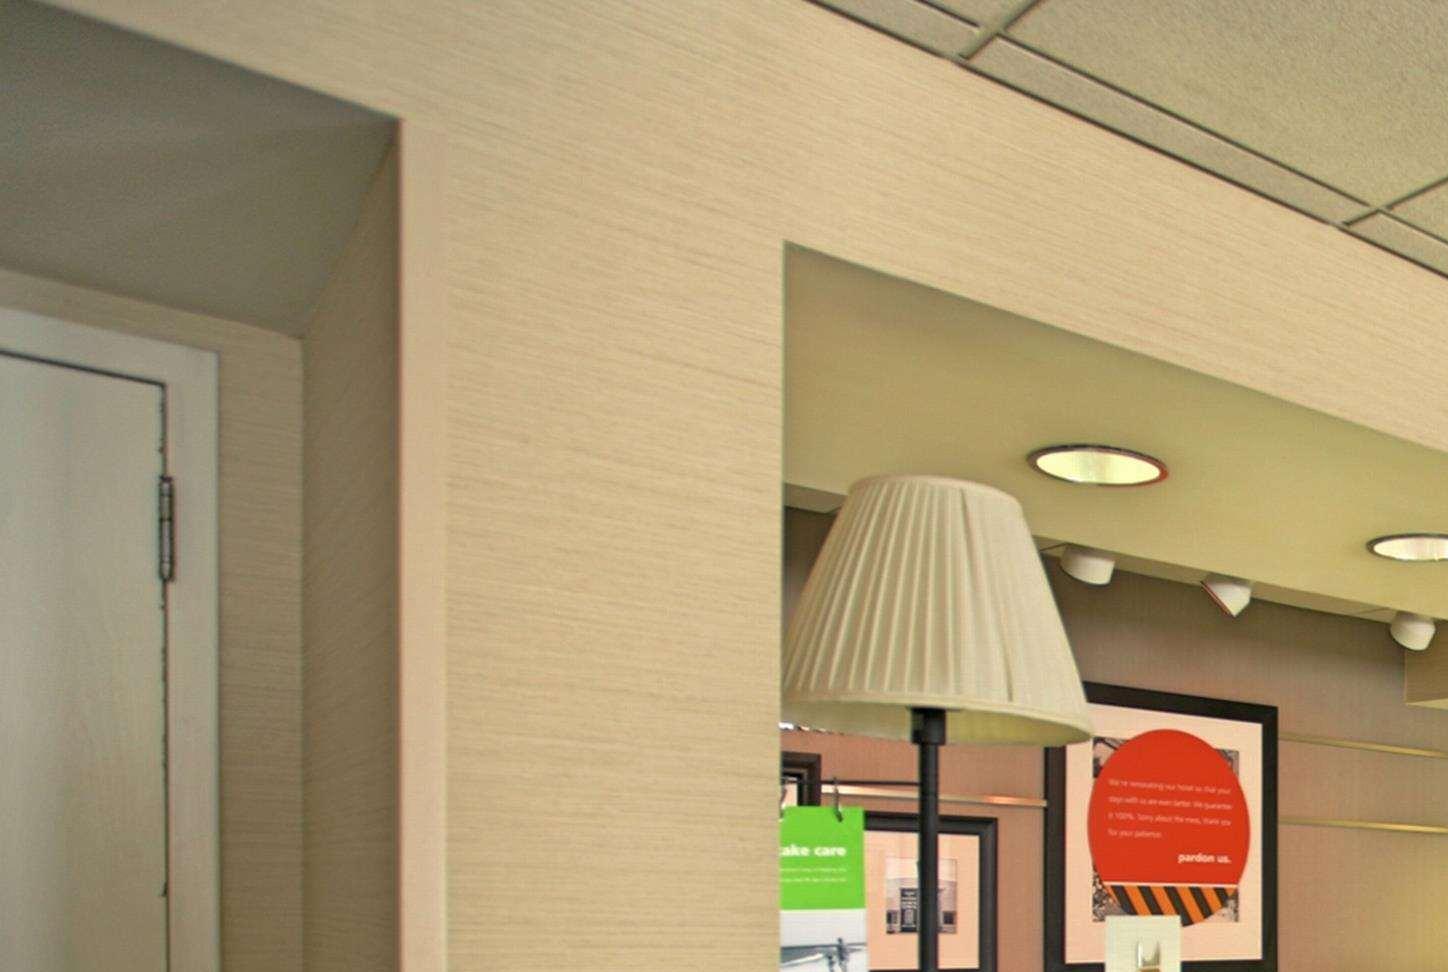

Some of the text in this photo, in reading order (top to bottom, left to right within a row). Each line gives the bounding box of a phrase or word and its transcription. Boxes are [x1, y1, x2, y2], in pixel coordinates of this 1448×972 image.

[780, 844, 847, 857] ake care
[1177, 852, 1231, 865] pardon us.
